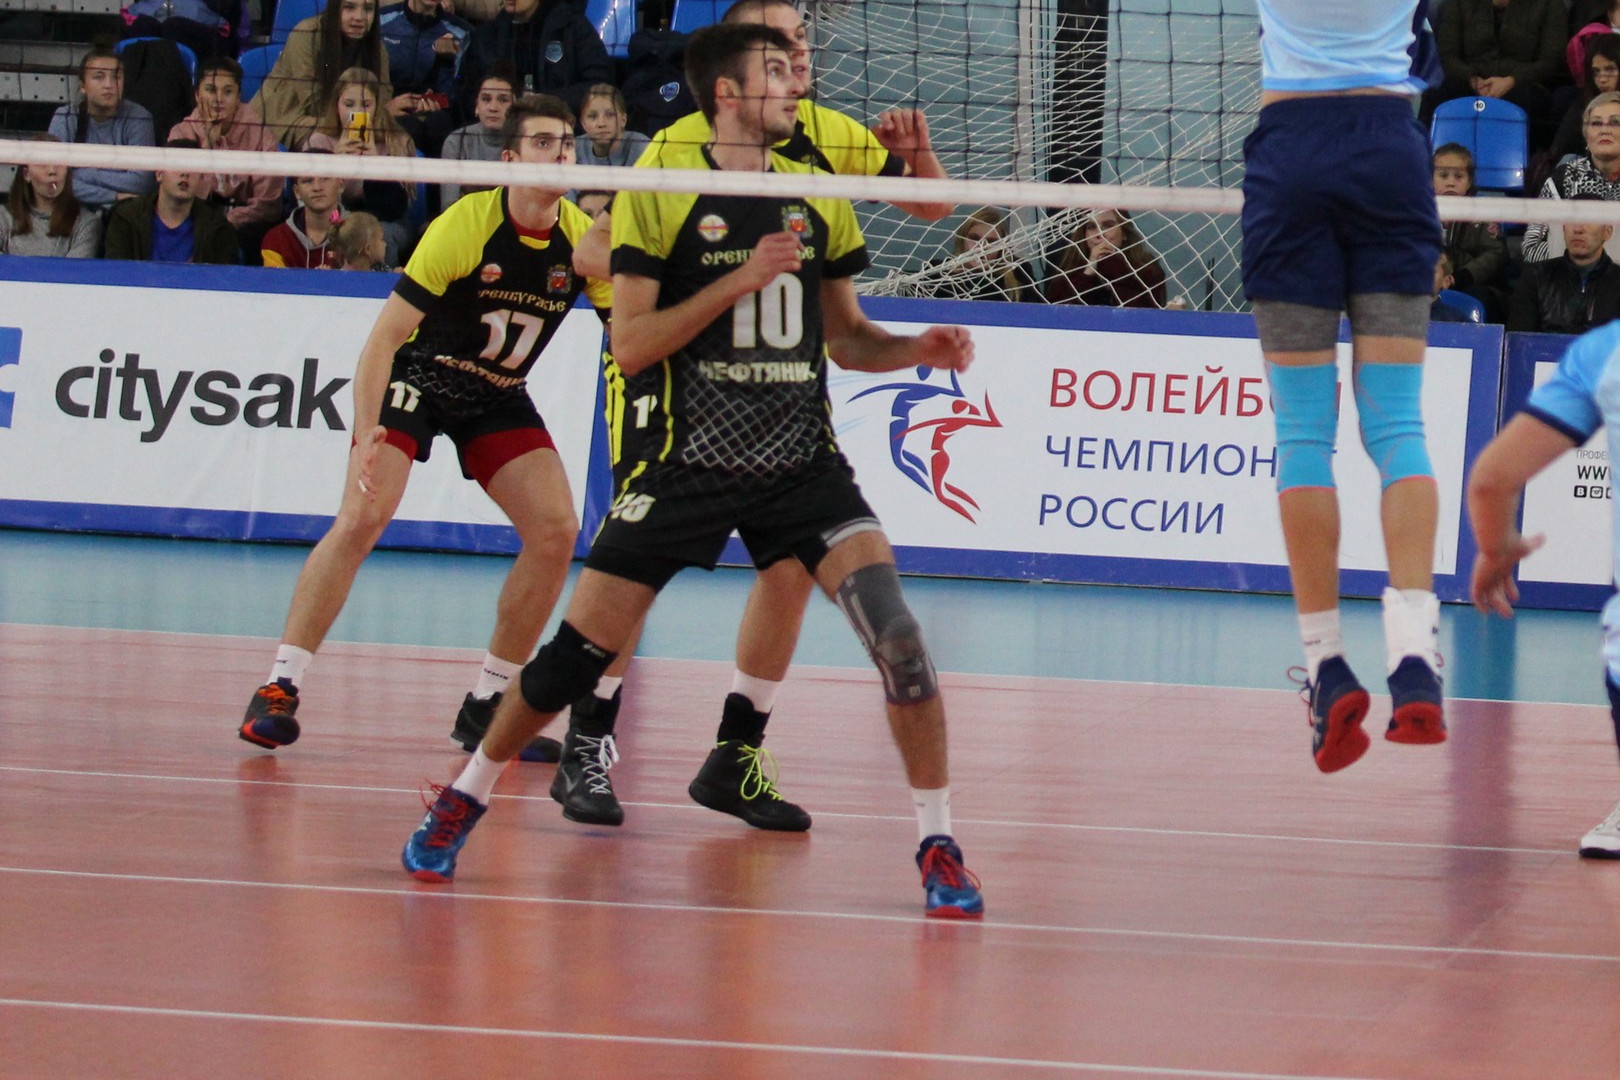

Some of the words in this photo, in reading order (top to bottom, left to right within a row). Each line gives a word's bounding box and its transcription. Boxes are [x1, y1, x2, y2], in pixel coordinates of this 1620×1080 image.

[702, 245, 816, 265] ОРЕНЬЕ
[478, 289, 567, 312] РЕНБУРЖЬЕ
[733, 272, 803, 349] 10
[480, 308, 545, 370] 17
[55, 349, 351, 444] citysak
[1049, 366, 1342, 422] ВОЛЕЙБ
[1045, 436, 1336, 480] ЧЕМПИОН
[1576, 449, 1607, 460] ПРОФЕ
[611, 492, 656, 523] 10
[1038, 493, 1226, 536] РОССИИ
